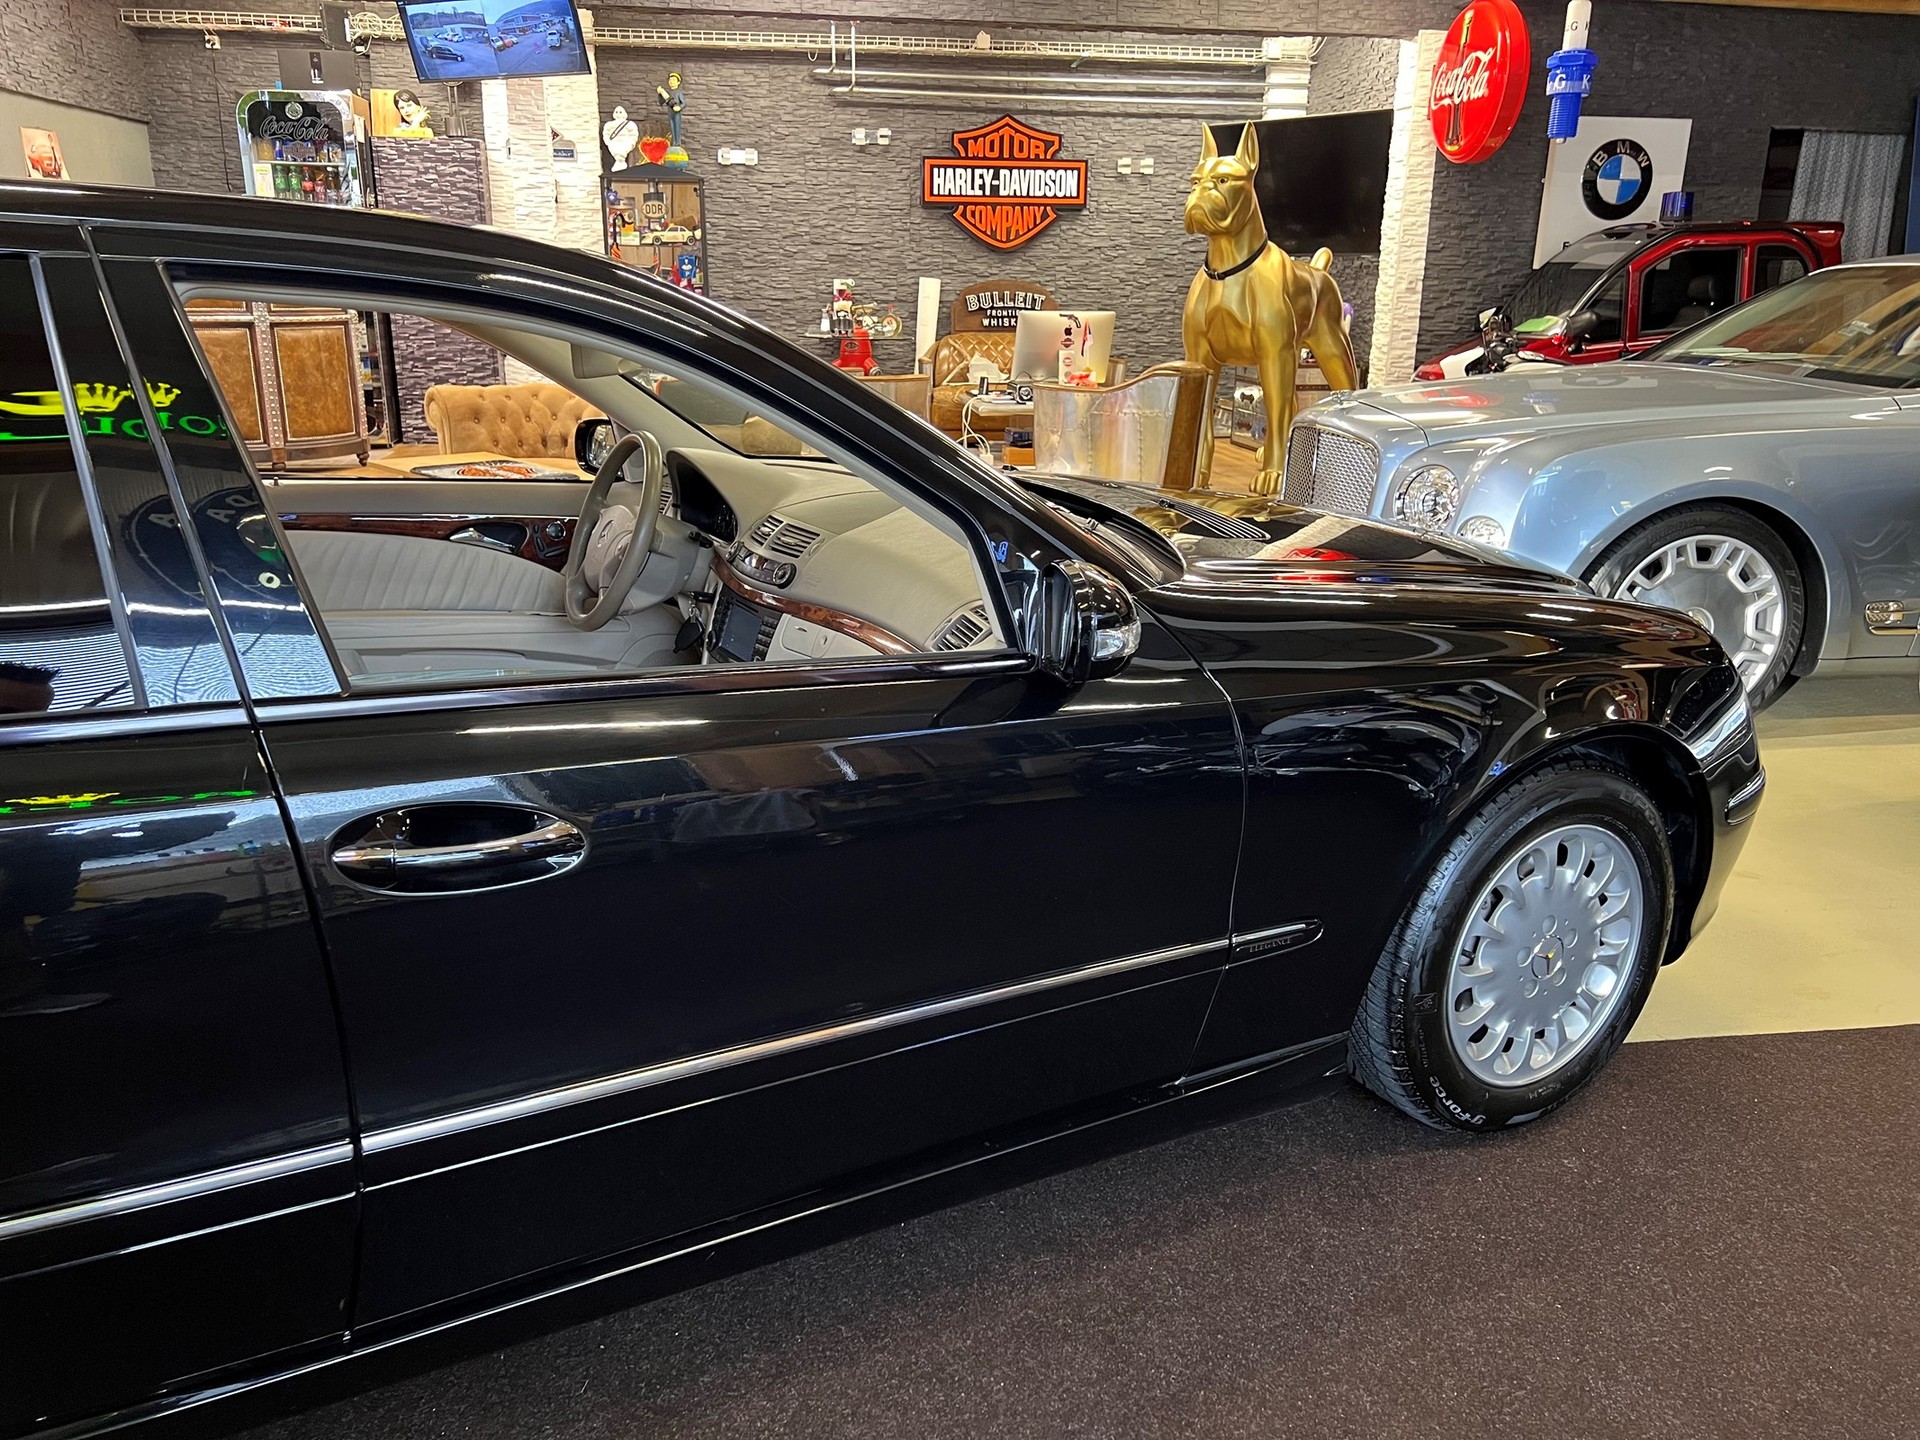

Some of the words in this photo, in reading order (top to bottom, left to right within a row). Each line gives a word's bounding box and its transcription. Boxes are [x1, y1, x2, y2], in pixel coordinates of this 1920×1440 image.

[968, 126, 1046, 159] MOTOR
[1592, 141, 1650, 168] BMW
[932, 167, 1079, 198] HARLEY-DAVIDSON
[645, 204, 664, 215] DDR
[966, 205, 1045, 242] COMPANY
[965, 290, 1047, 311] BULLEIT
[982, 317, 1017, 327] WHISK
[986, 309, 1020, 317] FRONTIE
